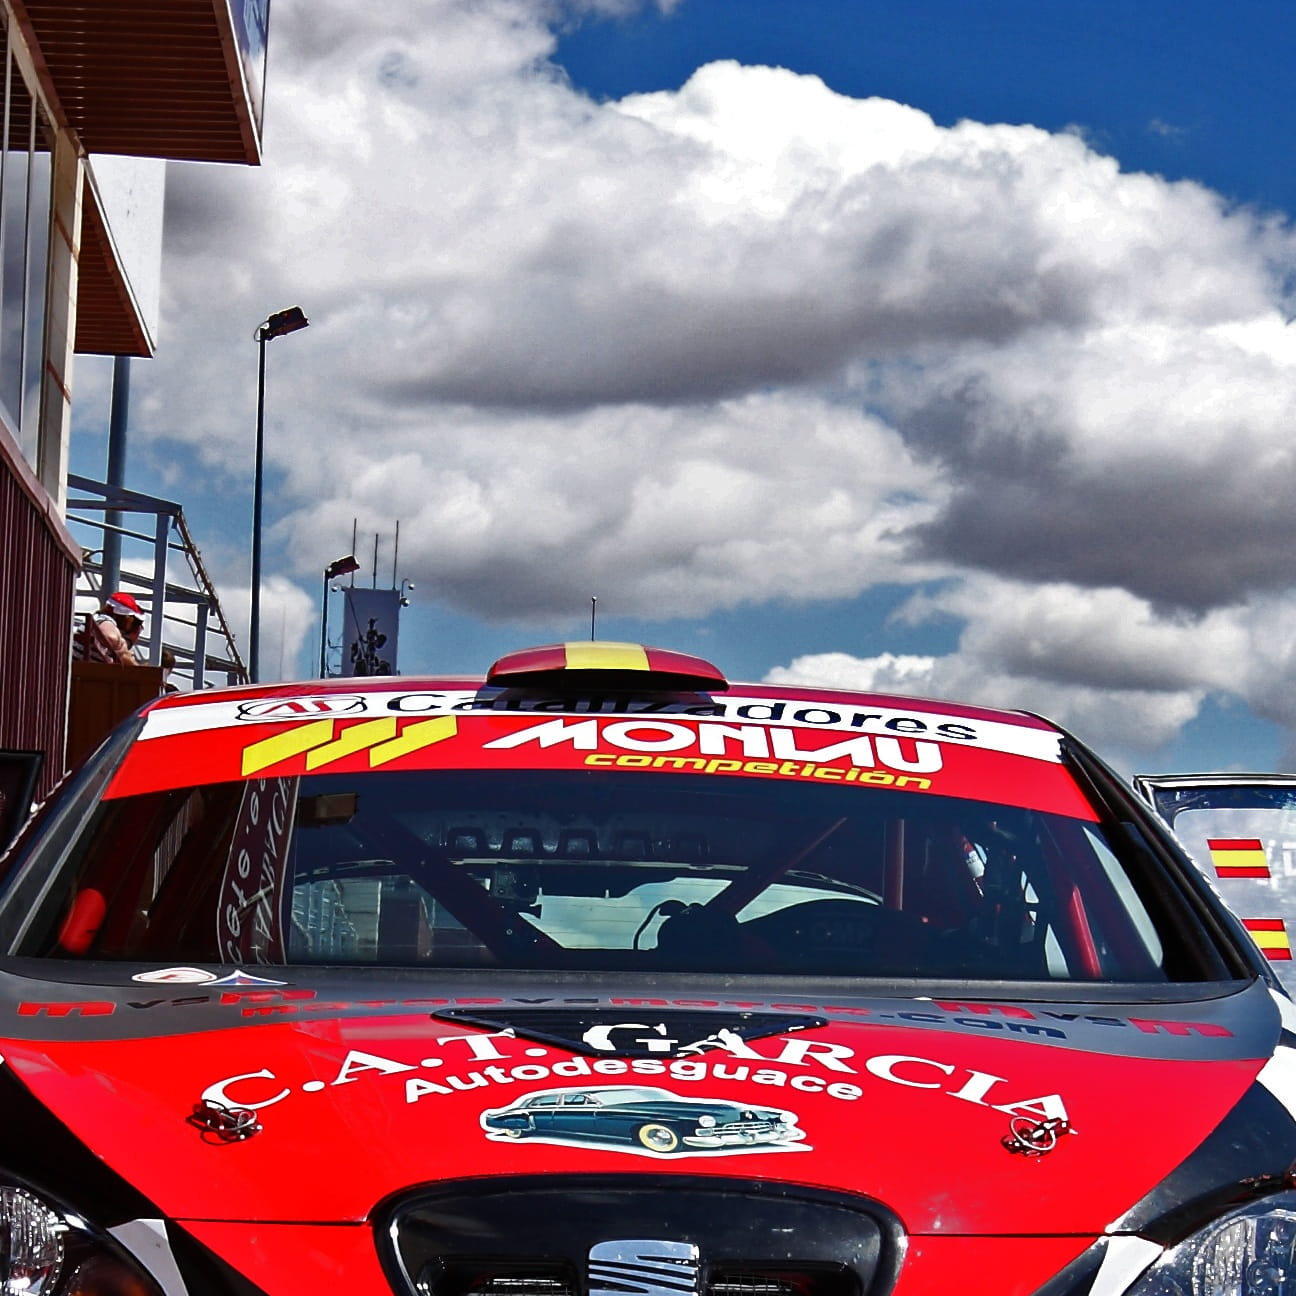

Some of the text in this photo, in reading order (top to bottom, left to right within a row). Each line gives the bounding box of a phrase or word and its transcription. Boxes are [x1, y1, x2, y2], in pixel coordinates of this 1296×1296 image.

[482, 718, 943, 774] MONLAU
[584, 753, 932, 791] competición
[404, 1054, 864, 1104] Autodesguace
[582, 1022, 1079, 1135] GARCIA
